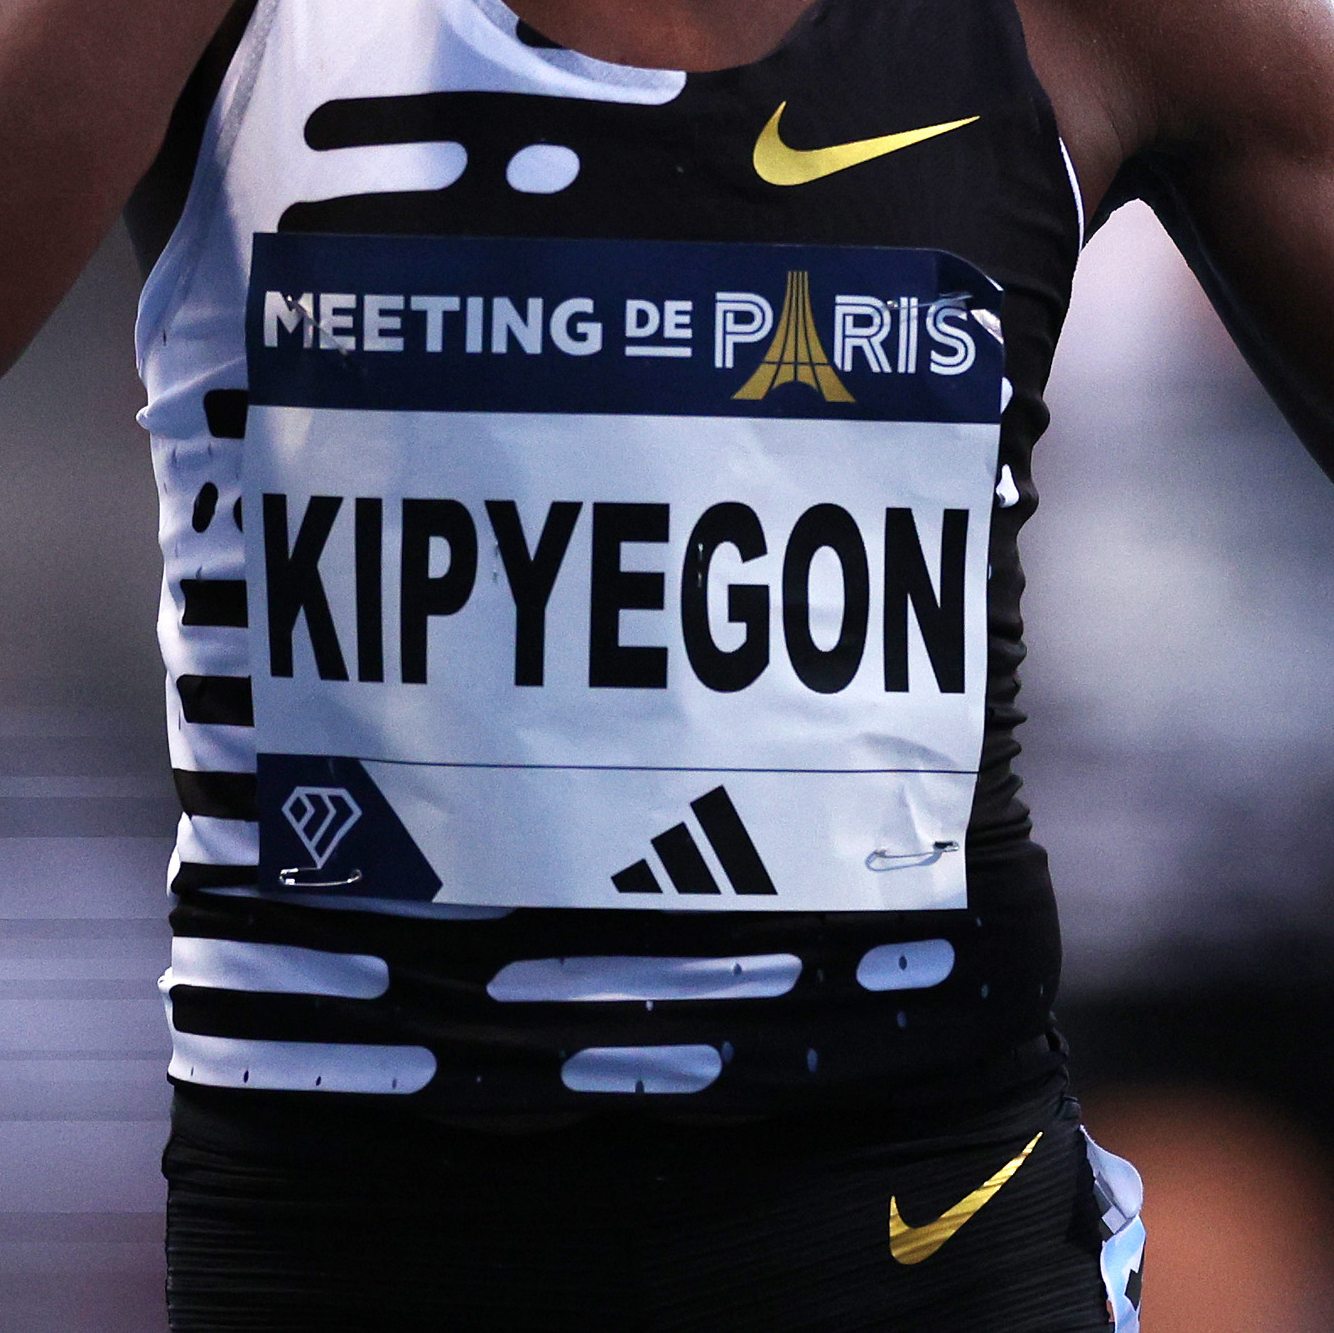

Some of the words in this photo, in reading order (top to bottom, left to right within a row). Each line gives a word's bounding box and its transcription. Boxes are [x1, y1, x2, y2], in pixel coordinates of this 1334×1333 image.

[263, 290, 603, 357] MEETING
[624, 299, 694, 344] DE
[713, 270, 977, 403] PARIS
[262, 493, 971, 695] KIPYEGON
